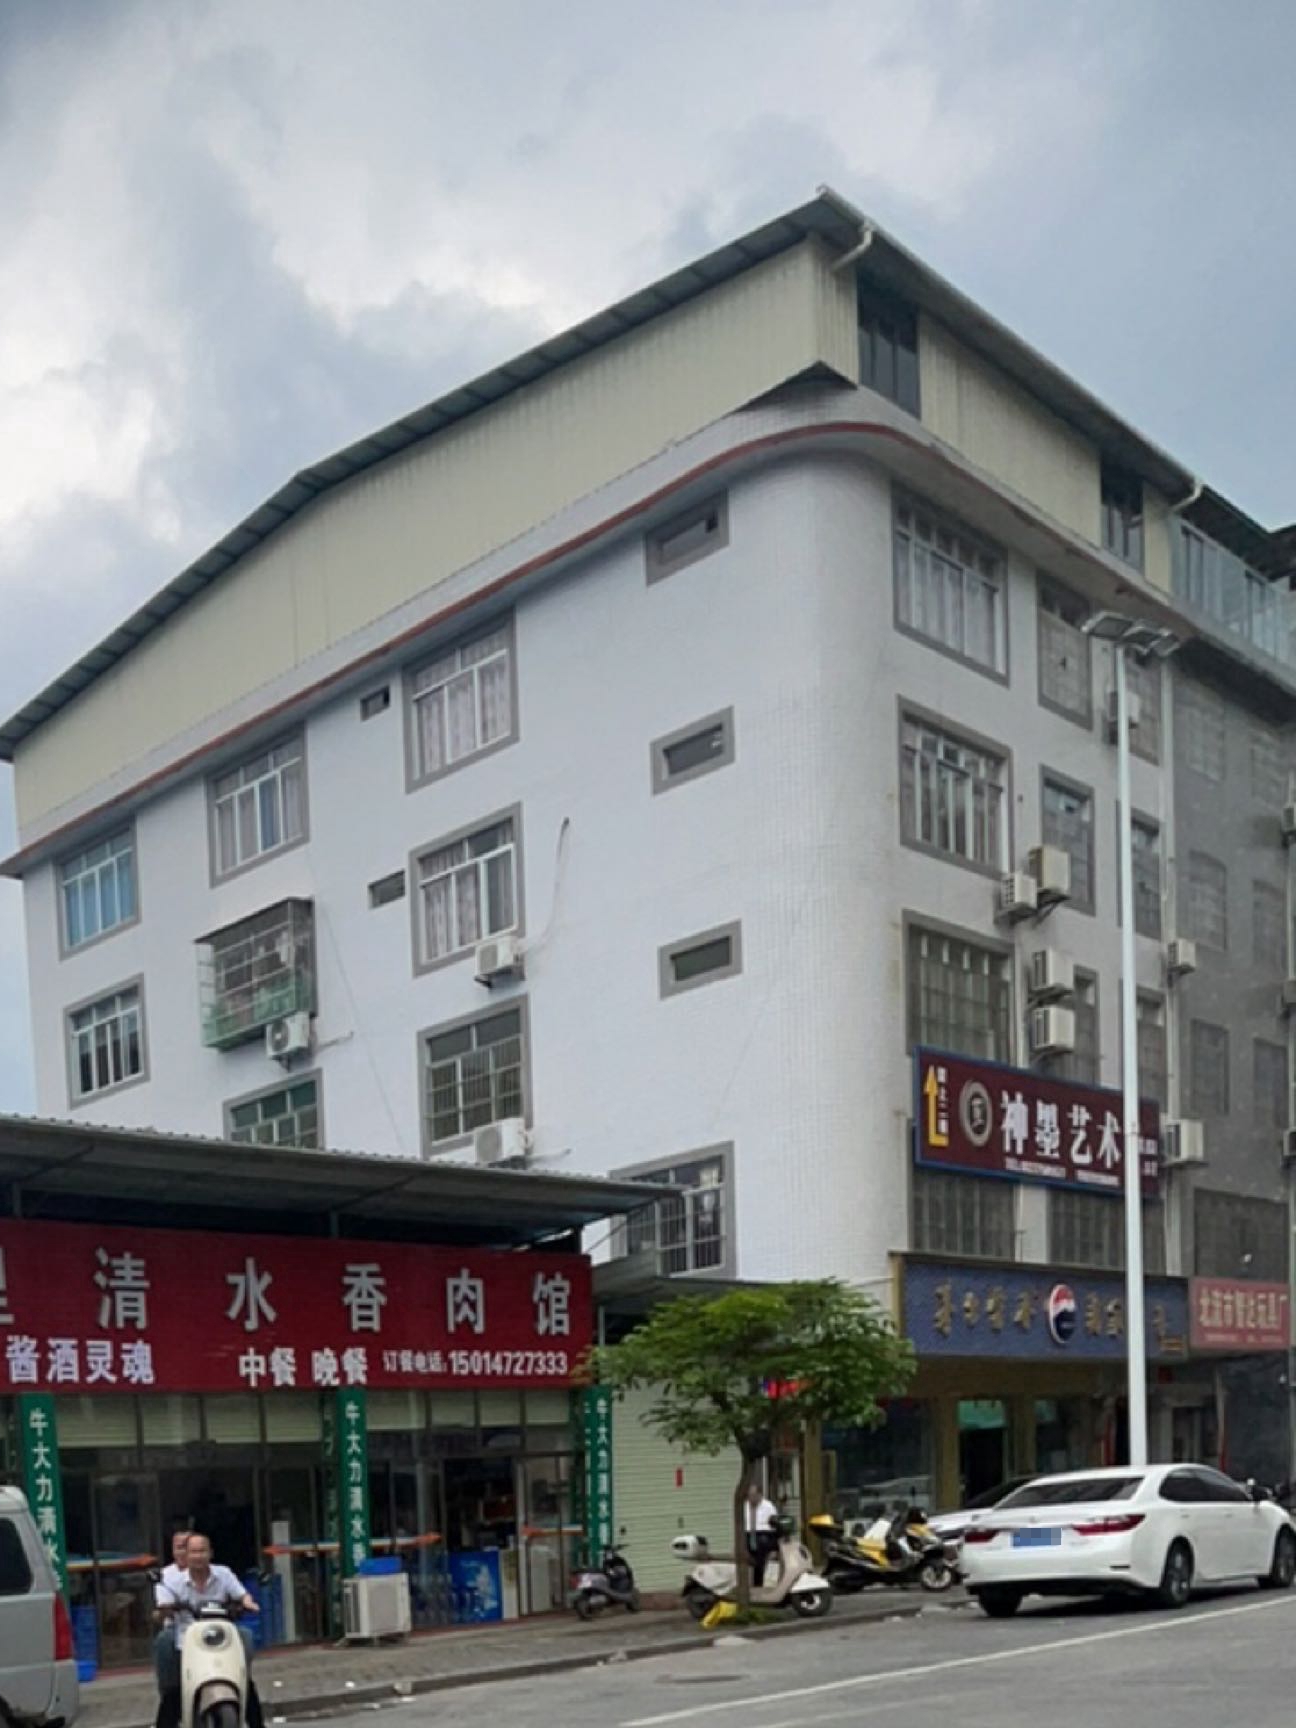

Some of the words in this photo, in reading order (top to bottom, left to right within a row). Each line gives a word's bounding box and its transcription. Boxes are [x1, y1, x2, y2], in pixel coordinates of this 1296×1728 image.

[6, 1335, 155, 1385] 酱酒灵魂
[238, 1347, 296, 1387] 中餐
[312, 1347, 368, 1386] 晚餐
